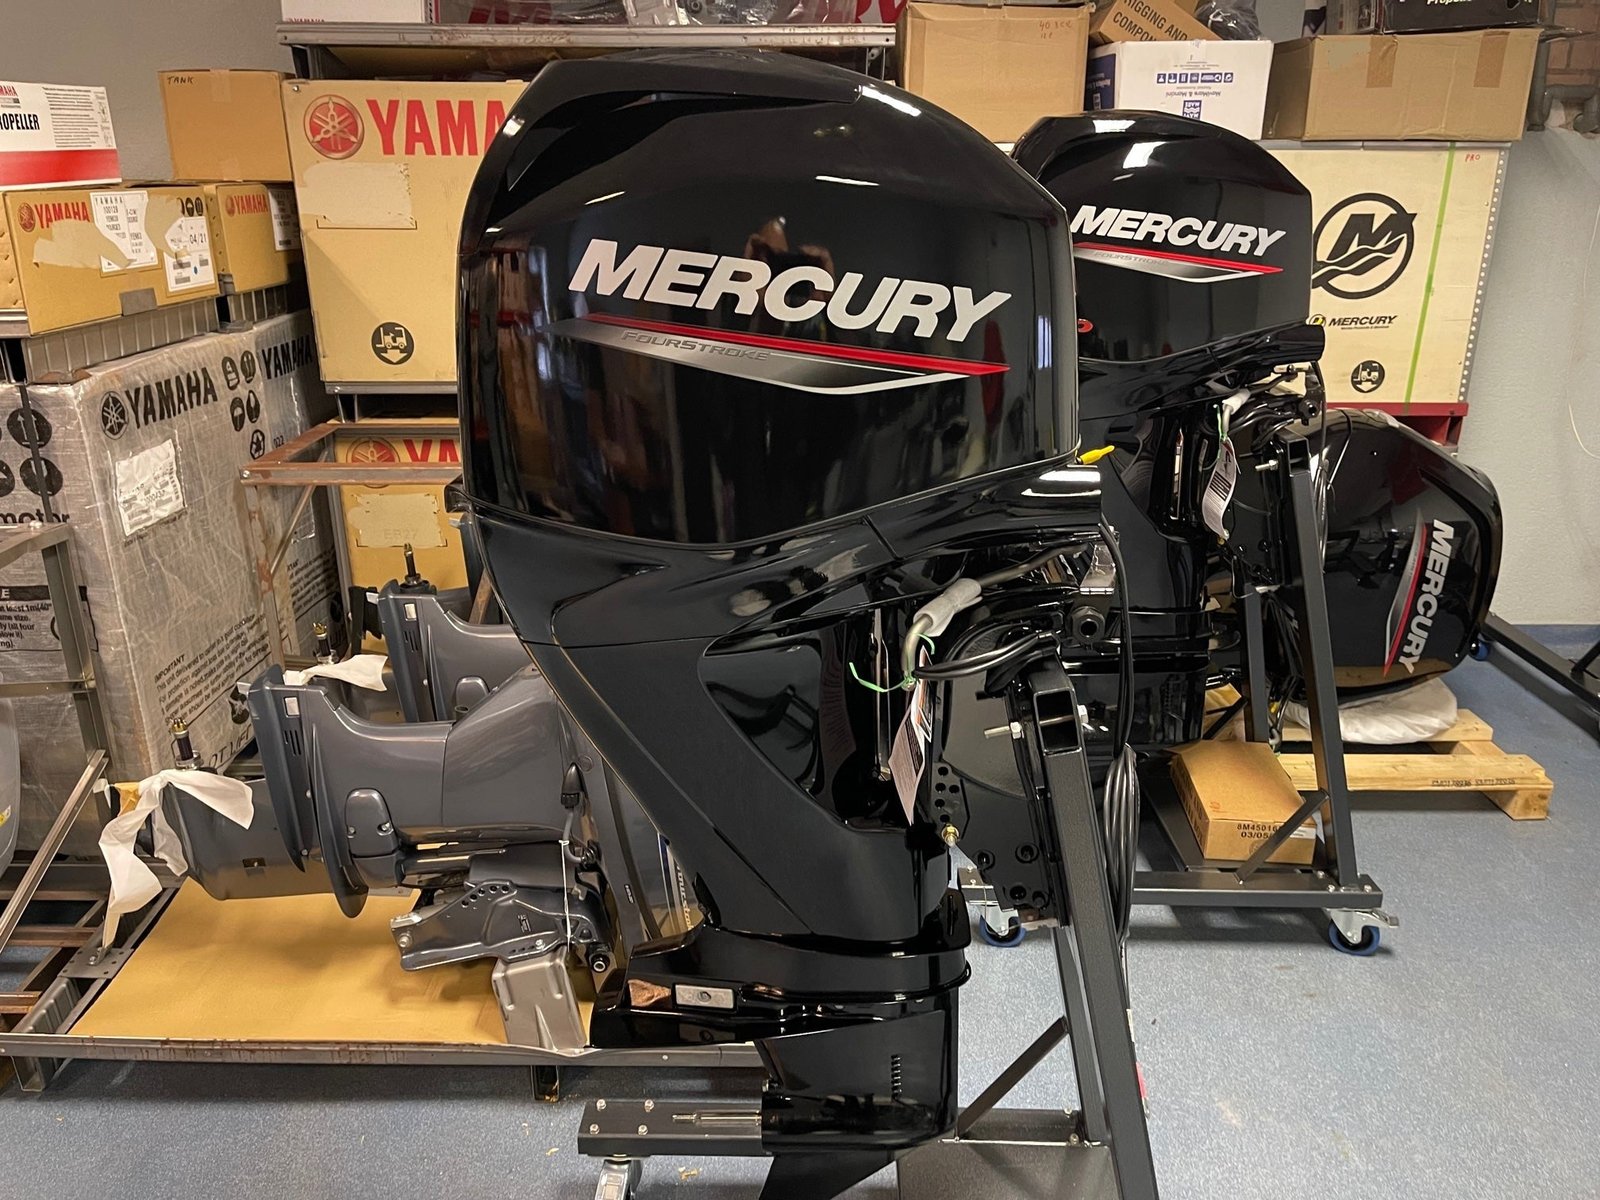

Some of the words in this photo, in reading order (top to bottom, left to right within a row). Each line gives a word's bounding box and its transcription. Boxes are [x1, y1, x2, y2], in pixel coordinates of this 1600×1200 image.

[167, 75, 194, 85] TANK
[233, 194, 269, 215] YAMAHA
[1070, 205, 1286, 257] MERCURY
[568, 238, 1012, 343] MERCURY
[1329, 315, 1398, 326] MERCURY
[621, 330, 772, 363] FOURSTROKE
[125, 366, 218, 429] YAMAHA
[1398, 519, 1454, 674] MERCURY
[153, 653, 185, 683] IMPORTANT
